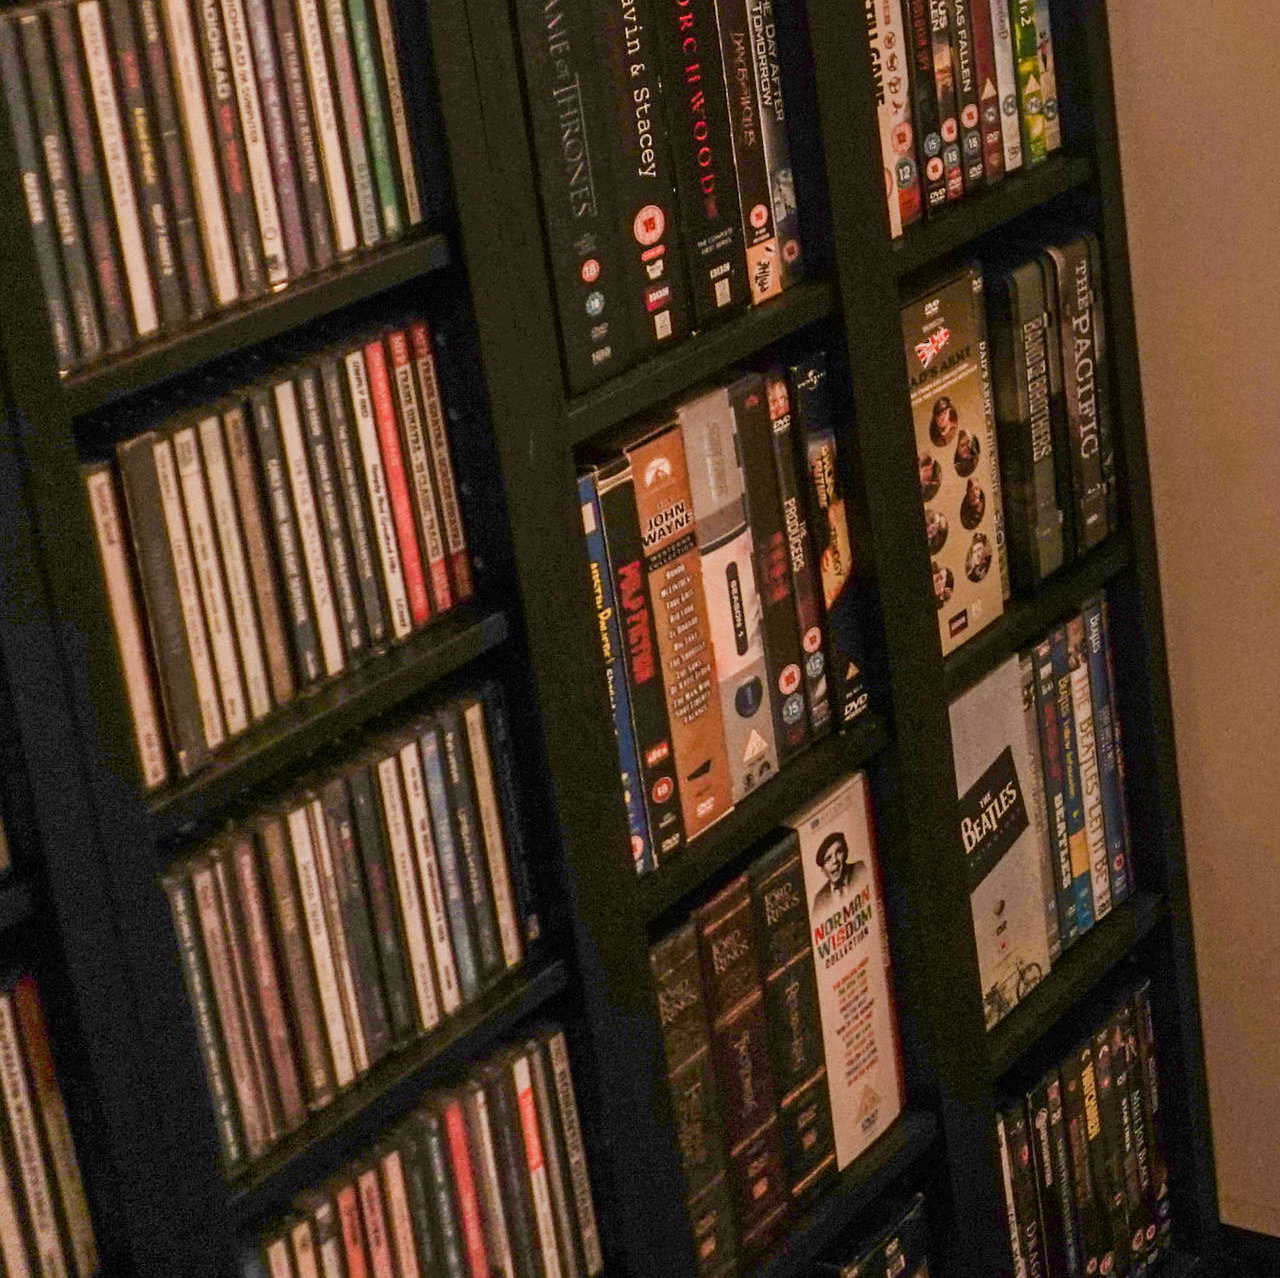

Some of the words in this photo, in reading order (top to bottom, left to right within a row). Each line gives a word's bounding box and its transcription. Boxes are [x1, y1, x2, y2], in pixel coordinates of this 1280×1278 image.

[752, 4, 773, 107] TOMORROW
[766, 23, 776, 58] DAY
[957, 28, 972, 93] FALLEN
[630, 62, 646, 78] &
[770, 63, 784, 122] AFTER
[634, 86, 656, 178] Stacey
[1074, 259, 1089, 311] THE
[978, 341, 989, 378] DAD'S
[397, 368, 413, 408] FRANK
[983, 382, 993, 415] ARMY
[1072, 315, 1099, 460] PACIFIC
[1028, 378, 1053, 463] BROTHERS
[642, 512, 694, 548] WAYNE
[648, 502, 685, 532] JOHN
[784, 497, 805, 573] PRODUCERS
[730, 578, 743, 628] SEASON
[844, 693, 868, 716] DVD
[1075, 676, 1091, 708] THE
[1079, 717, 1100, 796] BEATLES
[960, 780, 1018, 855] BEATLES
[979, 790, 992, 809] THE
[1054, 791, 1072, 890] BEATLES
[813, 884, 871, 946] NORMAN
[817, 906, 873, 959] WISDOM
[825, 928, 870, 970] COLLECTION
